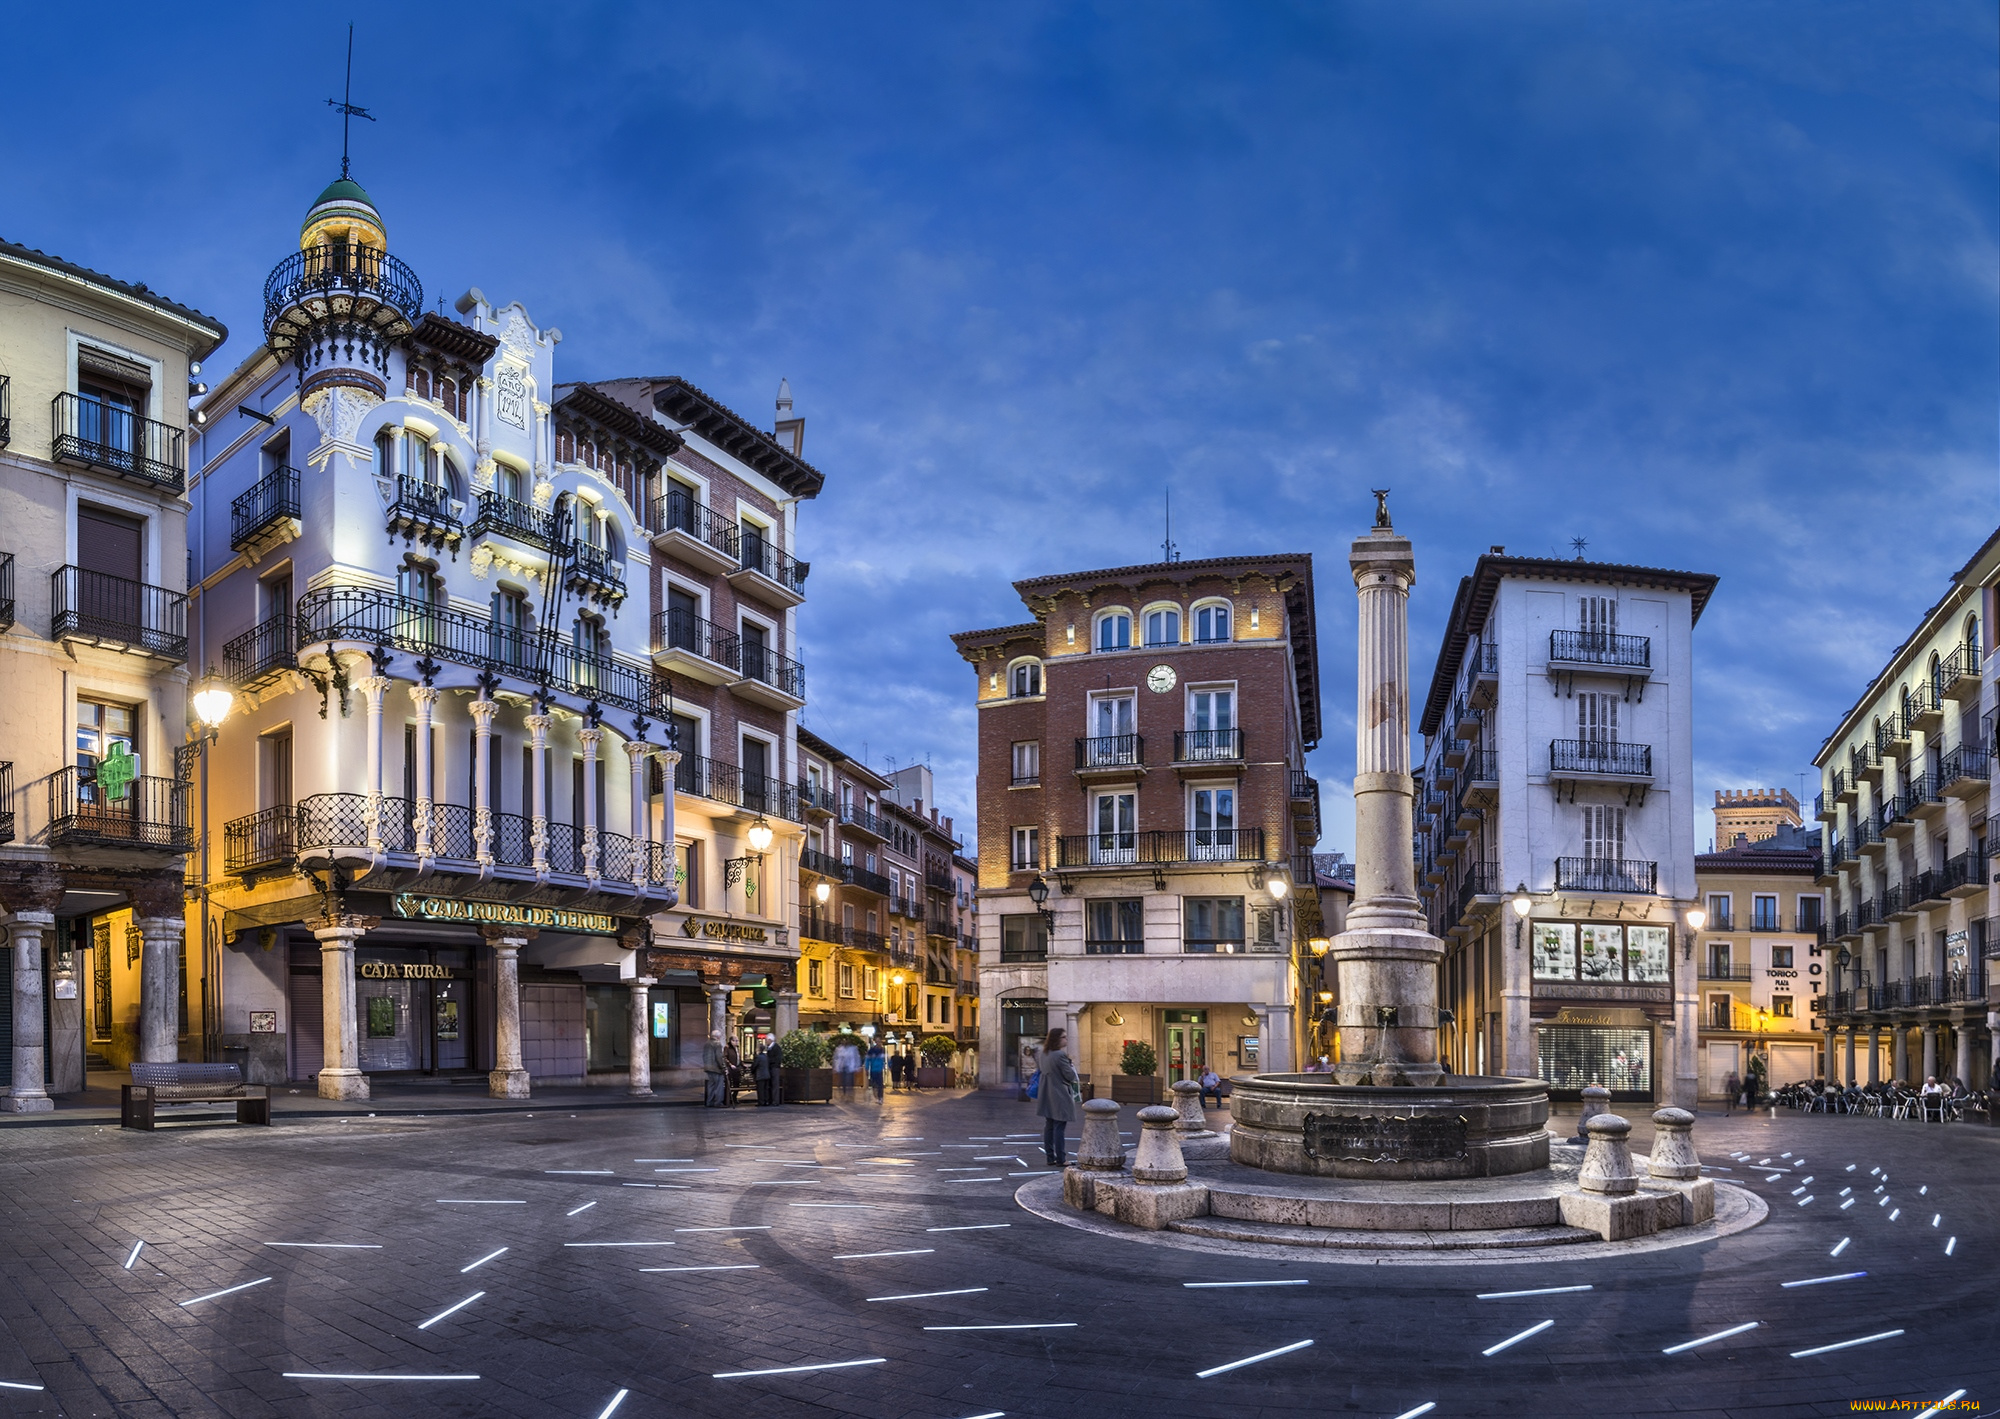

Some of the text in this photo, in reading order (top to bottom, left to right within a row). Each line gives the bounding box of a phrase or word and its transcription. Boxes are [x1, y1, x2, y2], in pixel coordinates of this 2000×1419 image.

[502, 396, 521, 419] 1912
[426, 898, 617, 932] CAJA RURAL DE TERUEL
[361, 963, 454, 979] CAJA RURAL
[1766, 970, 1798, 978] TORICO
[1620, 988, 1666, 1000] TEJIDOS
[1809, 944, 1822, 1030] HOTEL
